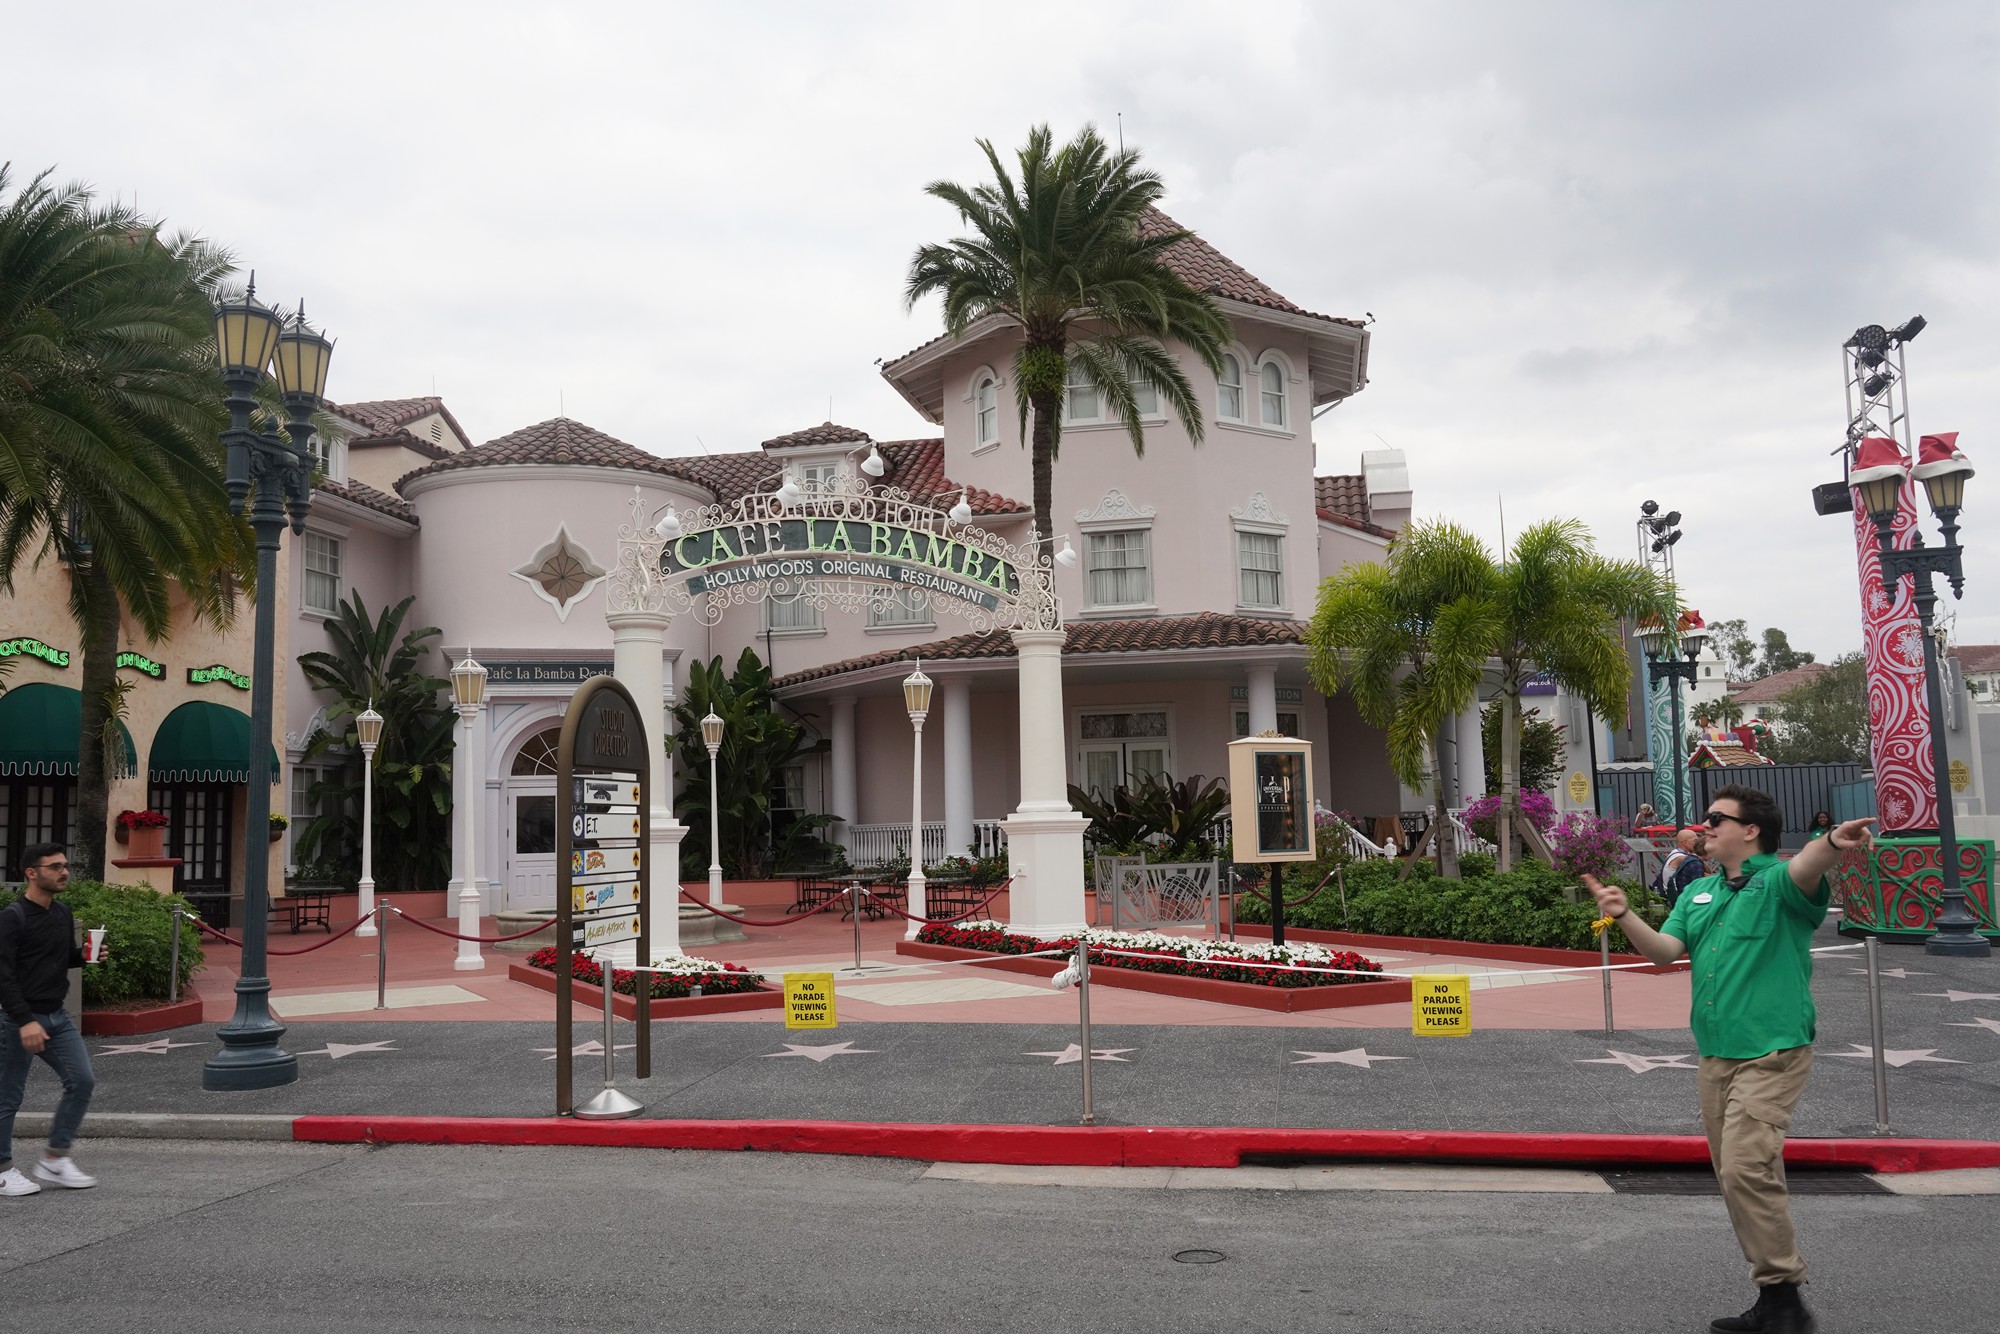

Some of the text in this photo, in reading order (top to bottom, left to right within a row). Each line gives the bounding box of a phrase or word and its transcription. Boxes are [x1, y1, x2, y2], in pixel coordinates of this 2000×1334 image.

[754, 498, 937, 533] HOLLYWOOD HOTEL
[675, 517, 1008, 592] CAFE LA BAMBA
[704, 561, 985, 604] HOLLYWOOD'S ORIGINAL RESTAURANT
[809, 582, 856, 595] SINCE
[0, 639, 69, 666] OCKTAILS
[116, 653, 160, 677] INING
[486, 667, 512, 679] Cafe
[517, 667, 530, 679] La
[534, 667, 575, 679] Bamba
[601, 708, 625, 732] STUDIO
[594, 732, 630, 757] DIRECTORY
[802, 983, 815, 991] NO
[1434, 985, 1448, 993] NO
[793, 993, 825, 1001] PARADE
[1423, 995, 1460, 1004] PARADE
[791, 1003, 827, 1011] VIEWING
[1422, 1006, 1463, 1015] VIEWING
[795, 1013, 825, 1021] PLEASE
[1426, 1017, 1460, 1026] PLEASE
